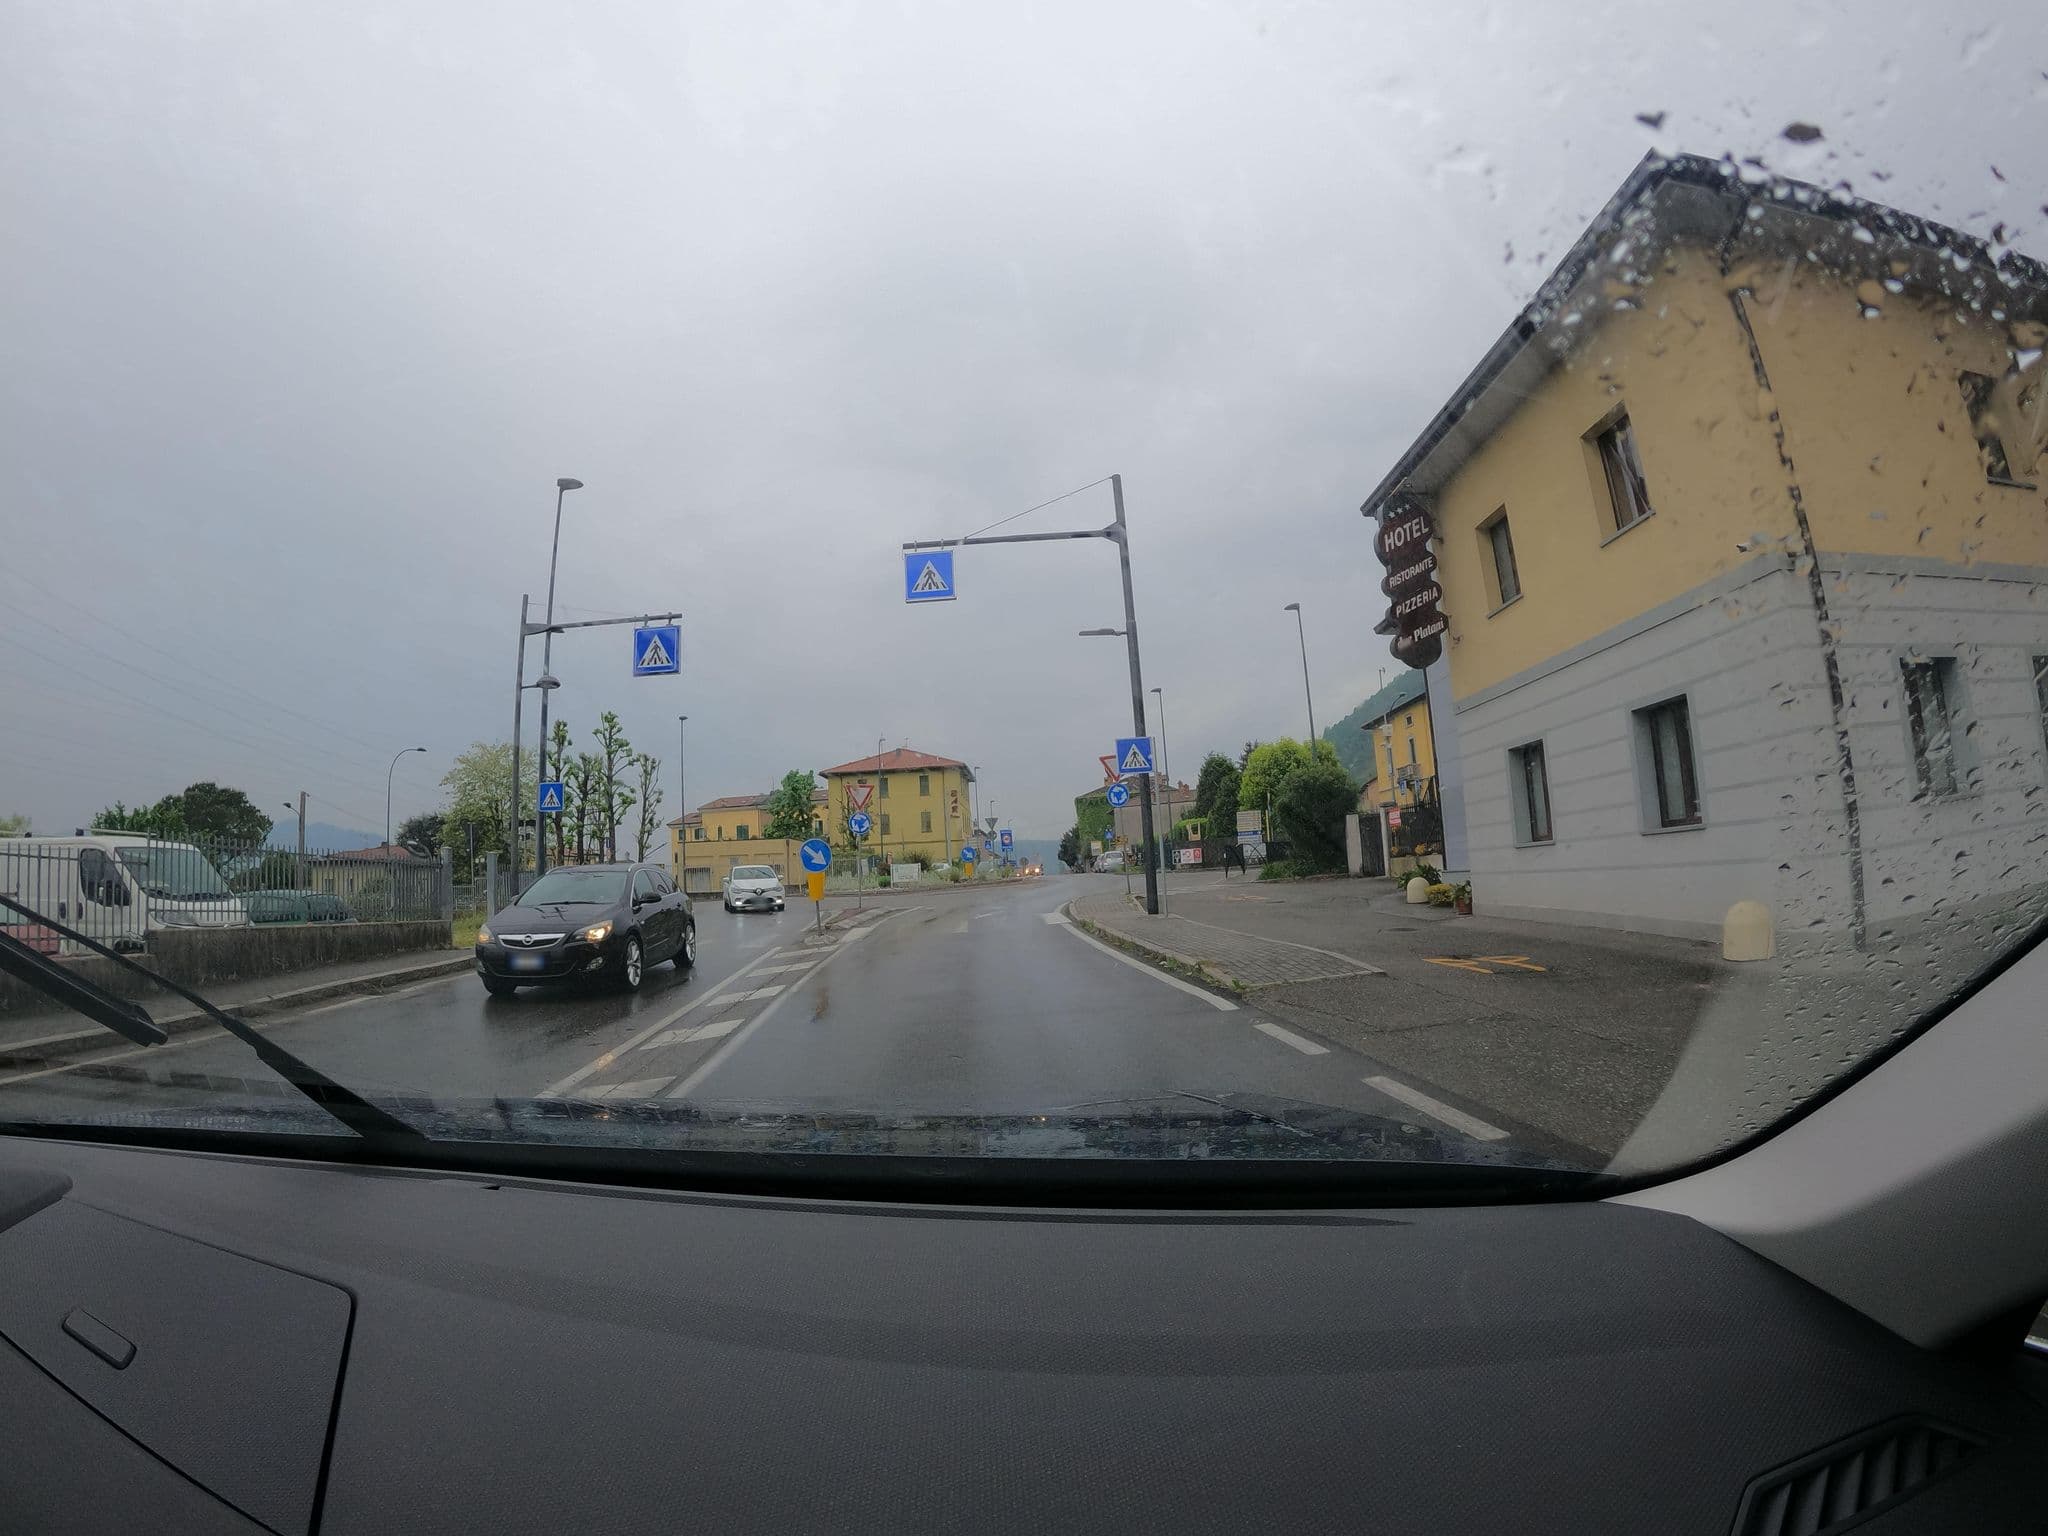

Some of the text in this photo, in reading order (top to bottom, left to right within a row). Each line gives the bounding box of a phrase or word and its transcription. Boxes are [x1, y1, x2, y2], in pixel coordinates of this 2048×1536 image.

[1385, 516, 1429, 552] HOTEL
[1389, 556, 1433, 588] RISTORANTE
[1396, 586, 1438, 617] PIZZERIA
[1414, 617, 1444, 642] Platani
